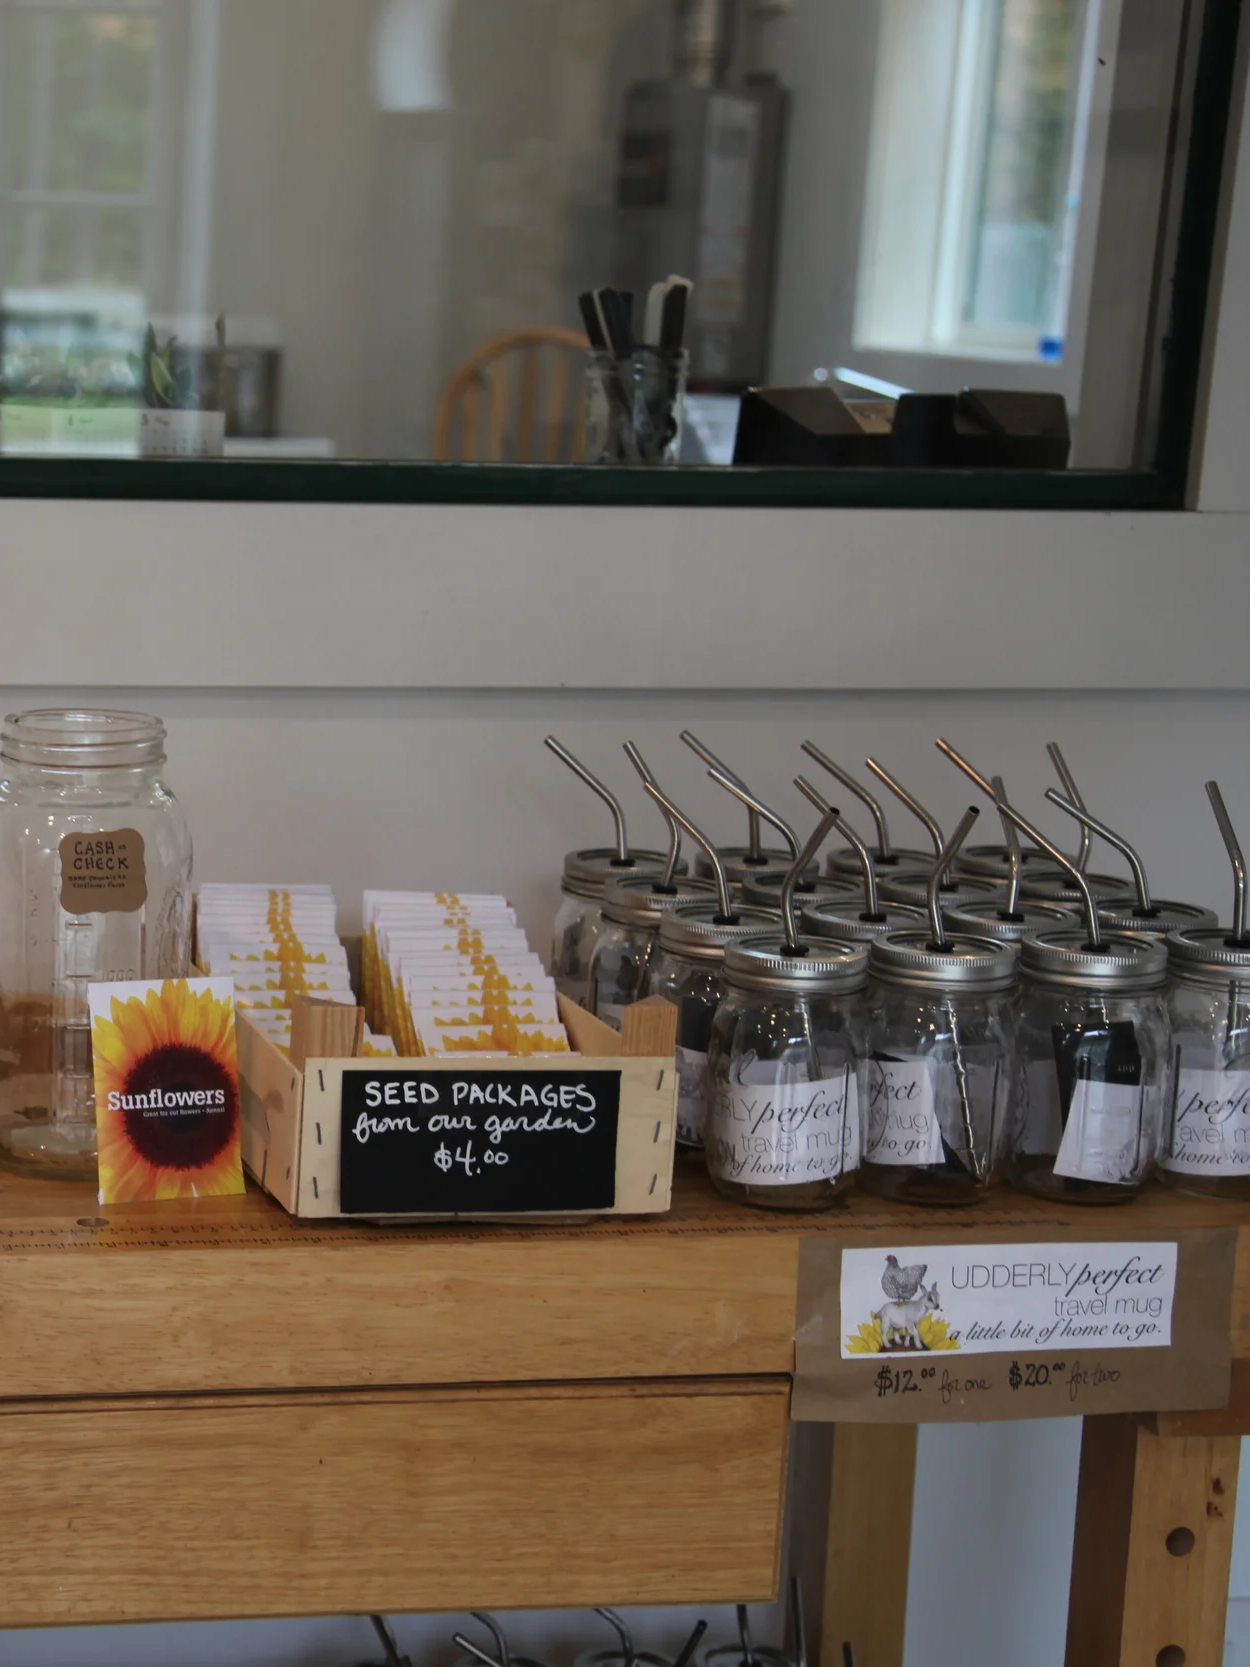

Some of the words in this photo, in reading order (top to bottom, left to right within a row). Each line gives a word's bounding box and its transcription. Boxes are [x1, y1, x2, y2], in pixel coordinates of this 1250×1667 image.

[75, 841, 115, 856] CASH
[73, 857, 129, 870] CHECK
[108, 1089, 225, 1111] Sunflowers
[365, 1081, 440, 1107] SEED
[452, 1081, 596, 1112] PACKAGES
[870, 1072, 922, 1107] fect
[143, 1110, 159, 1118] Great
[180, 1107, 201, 1116] flowers
[206, 1106, 225, 1114] Annual
[352, 1112, 420, 1143] from
[428, 1115, 476, 1132] our
[484, 1108, 596, 1144] garden
[741, 1132, 798, 1153] travel
[807, 1126, 852, 1150] mug
[434, 1140, 509, 1176] $4.00
[951, 1263, 1076, 1289] UDDERLY
[1065, 1256, 1163, 1298] perfect
[1054, 1295, 1108, 1317] travel
[1114, 1296, 1163, 1318] mug
[949, 1330, 961, 1342] a
[965, 1321, 1006, 1342] little
[1009, 1320, 1034, 1340] bit
[1035, 1318, 1064, 1345] of
[1061, 1318, 1108, 1338] home
[1112, 1322, 1130, 1336] to
[1129, 1322, 1162, 1343] go.
[874, 1365, 936, 1397] $12.00
[965, 1378, 993, 1392] one
[1009, 1360, 1066, 1391] $20.00
[1091, 1368, 1121, 1386] two
